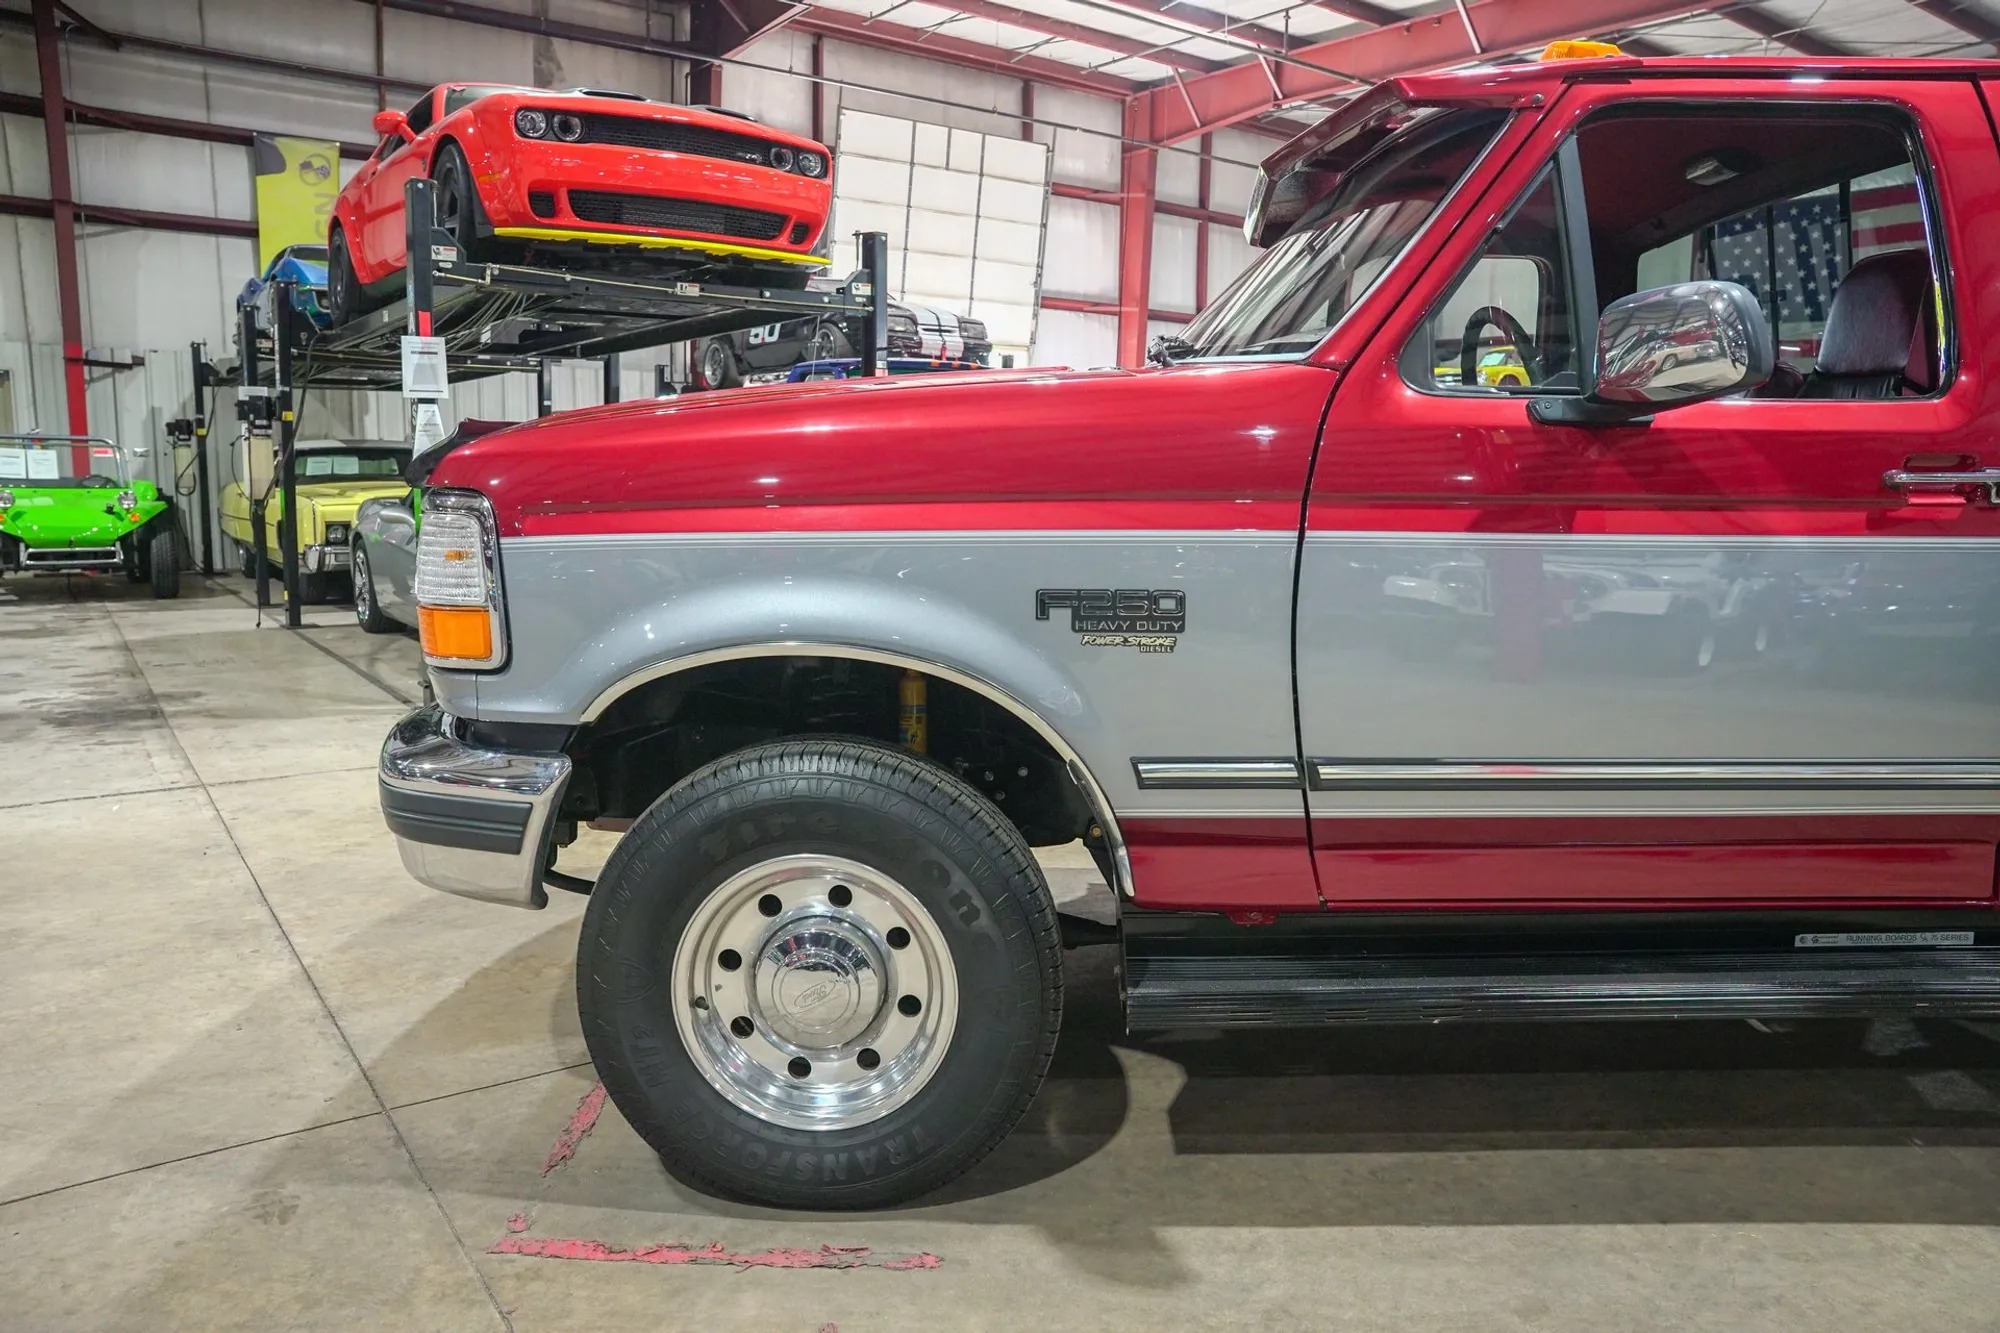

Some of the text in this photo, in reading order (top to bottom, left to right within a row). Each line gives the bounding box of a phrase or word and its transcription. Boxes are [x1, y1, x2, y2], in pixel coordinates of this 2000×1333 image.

[1075, 620, 1183, 631] HEAVY DUTY
[1081, 634, 1177, 647] POWER STROKE
[1140, 645, 1174, 654] DIESEL
[1846, 934, 1883, 943] RUNNING
[1885, 934, 1918, 942] BOARDS
[1939, 933, 1970, 941] SERIES
